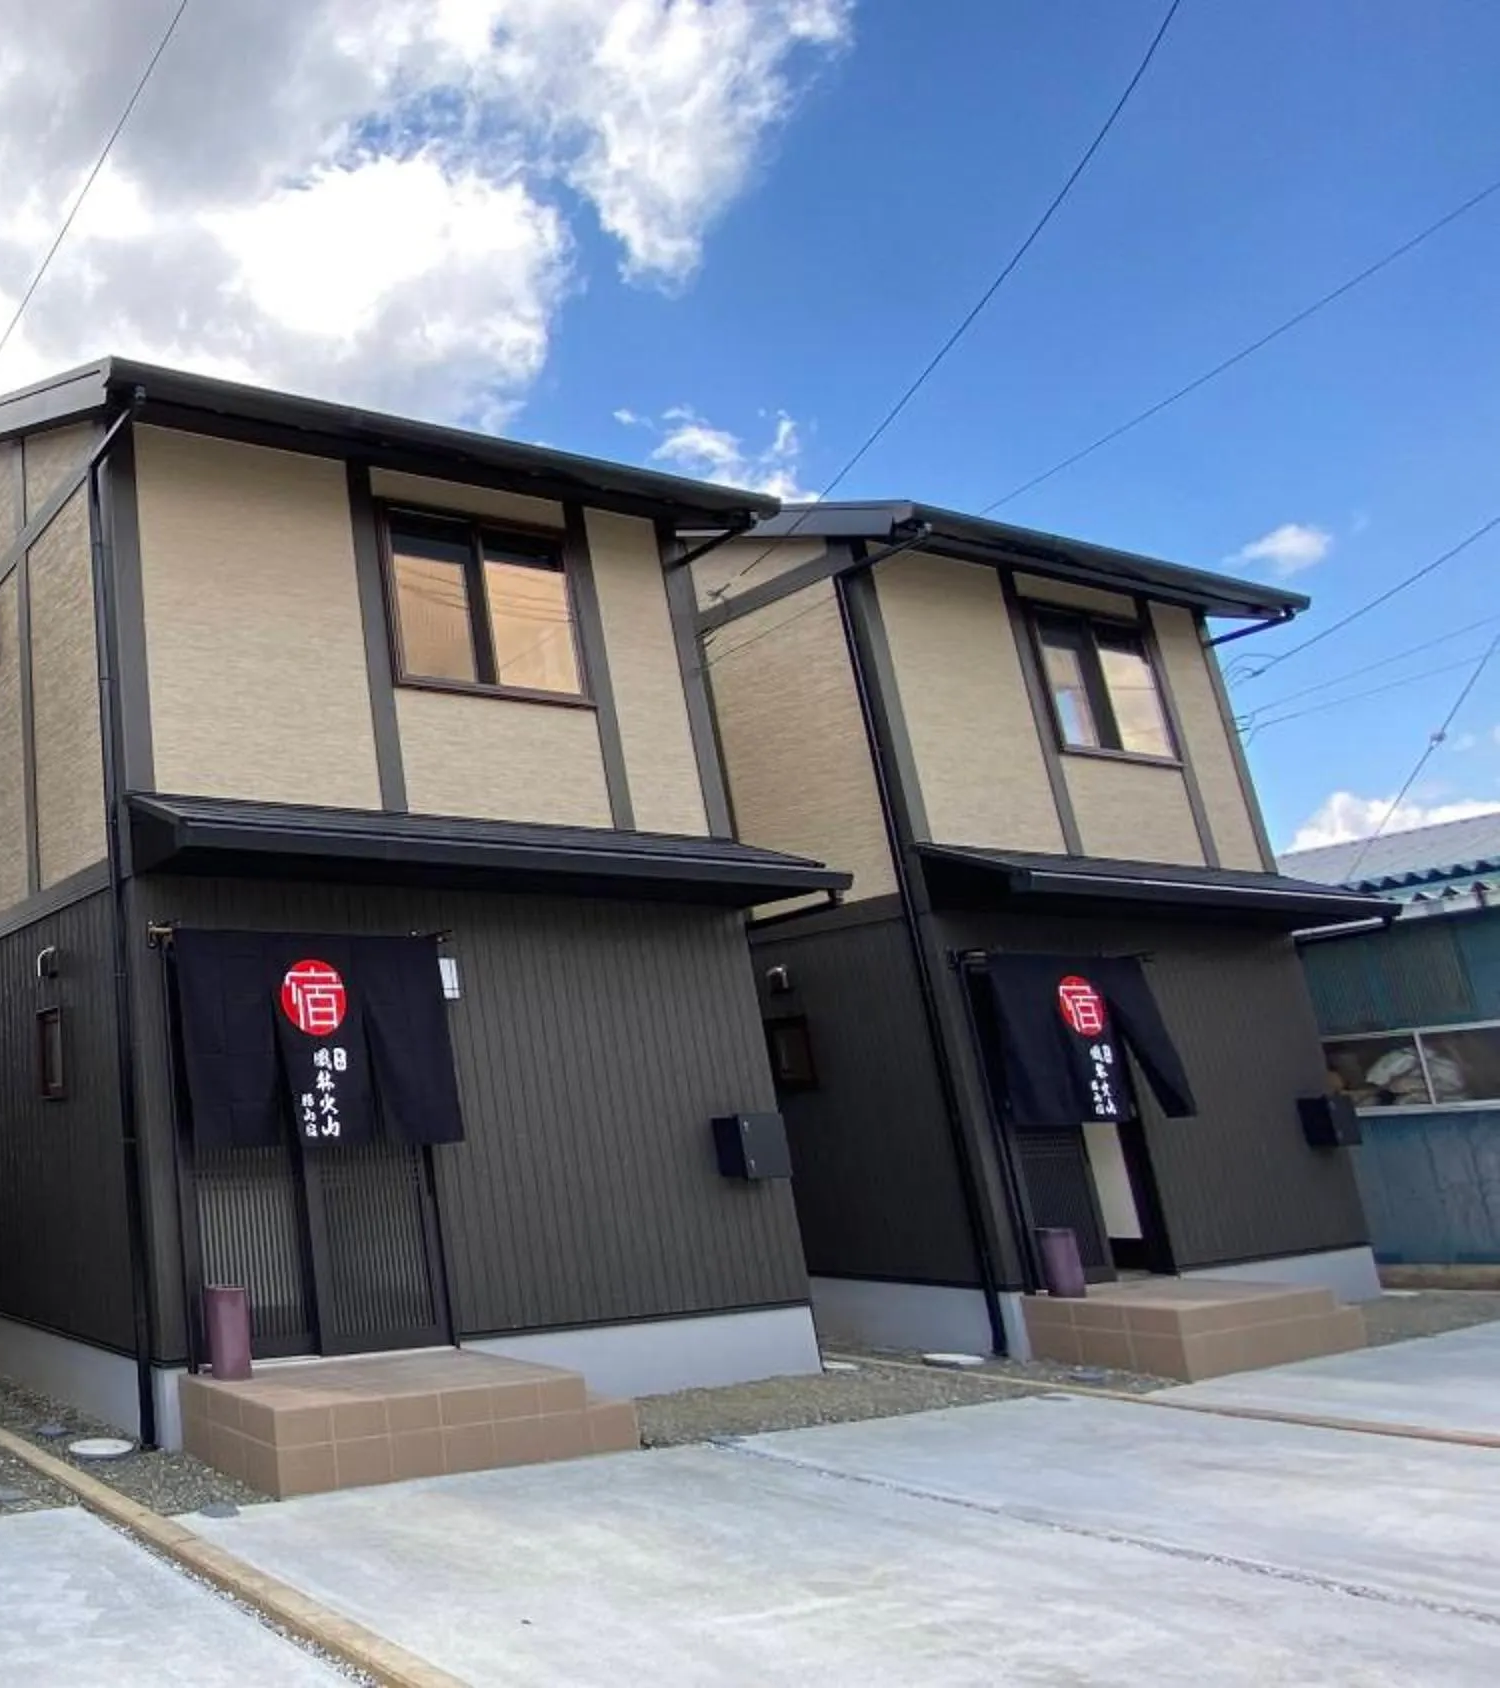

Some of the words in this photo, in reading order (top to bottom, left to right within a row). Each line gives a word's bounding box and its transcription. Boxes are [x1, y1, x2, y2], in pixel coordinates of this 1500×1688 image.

[285, 967, 344, 1031] 宿
[314, 1047, 341, 1137] 風林火山
